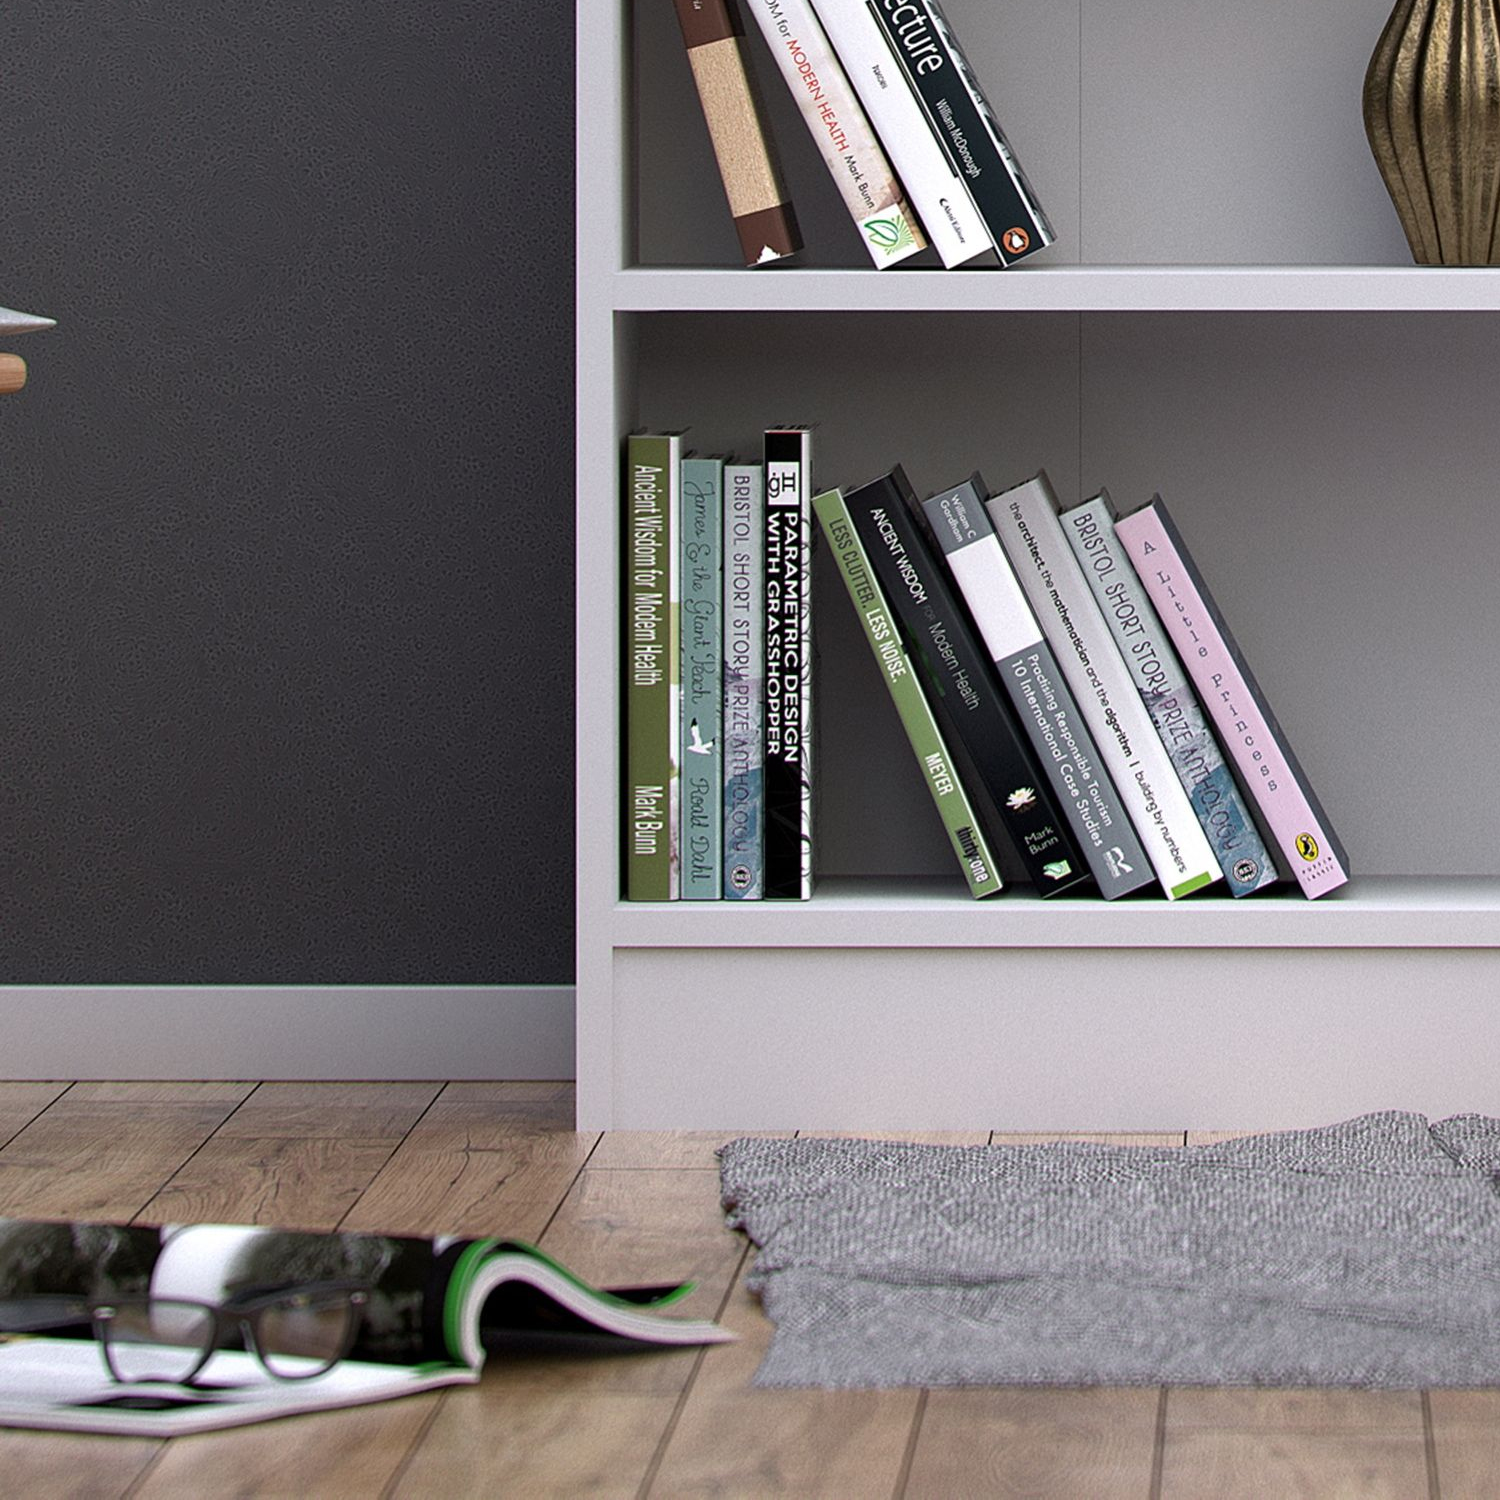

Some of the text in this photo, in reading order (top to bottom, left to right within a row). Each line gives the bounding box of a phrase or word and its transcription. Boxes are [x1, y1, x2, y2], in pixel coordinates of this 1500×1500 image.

[776, 19, 790, 37] for
[786, 39, 824, 101] MODERN
[817, 101, 849, 151] HEALTH
[935, 98, 981, 178] William McDonough
[844, 155, 874, 208] Mark Bunn
[733, 475, 750, 545] BRISTOL
[940, 499, 963, 542] Gardham
[951, 493, 976, 538] William C
[634, 464, 663, 685] Ancient Wisdom for Modern Health
[683, 480, 715, 704] James & the Giant Peach
[732, 552, 750, 611] SHORT
[828, 517, 906, 682] LESS CLUTTER. LESS NOISE.
[870, 508, 979, 710] ANCIENT WISDOM FOR Modern Health
[731, 618, 749, 678] STORY
[767, 511, 780, 754] WITH GRASSHOPPER
[784, 512, 798, 761] PARAMETRIC DESIGN
[1009, 502, 1132, 757] the architect, the mathematician and the algorithm
[1073, 512, 1241, 850] BRISTOL SHORT STORY PRIZE ANTHOLOGY
[1144, 540, 1156, 555] A
[1211, 673, 1277, 788] Princess
[732, 684, 749, 730] PRIZE
[1011, 659, 1102, 846] 10 International Case Studies
[1027, 653, 1057, 710] Practising
[1054, 710, 1091, 779] Responsible
[1087, 780, 1112, 826] Tourism
[634, 785, 663, 853] Mark Bunn
[731, 736, 749, 851] ANTHOLOGY
[924, 752, 953, 795] MEYER
[1134, 770, 1186, 873] building by numbers
[689, 777, 713, 883] Roald Dahl
[1024, 826, 1053, 844] Mark
[1028, 836, 1058, 854] Bunn
